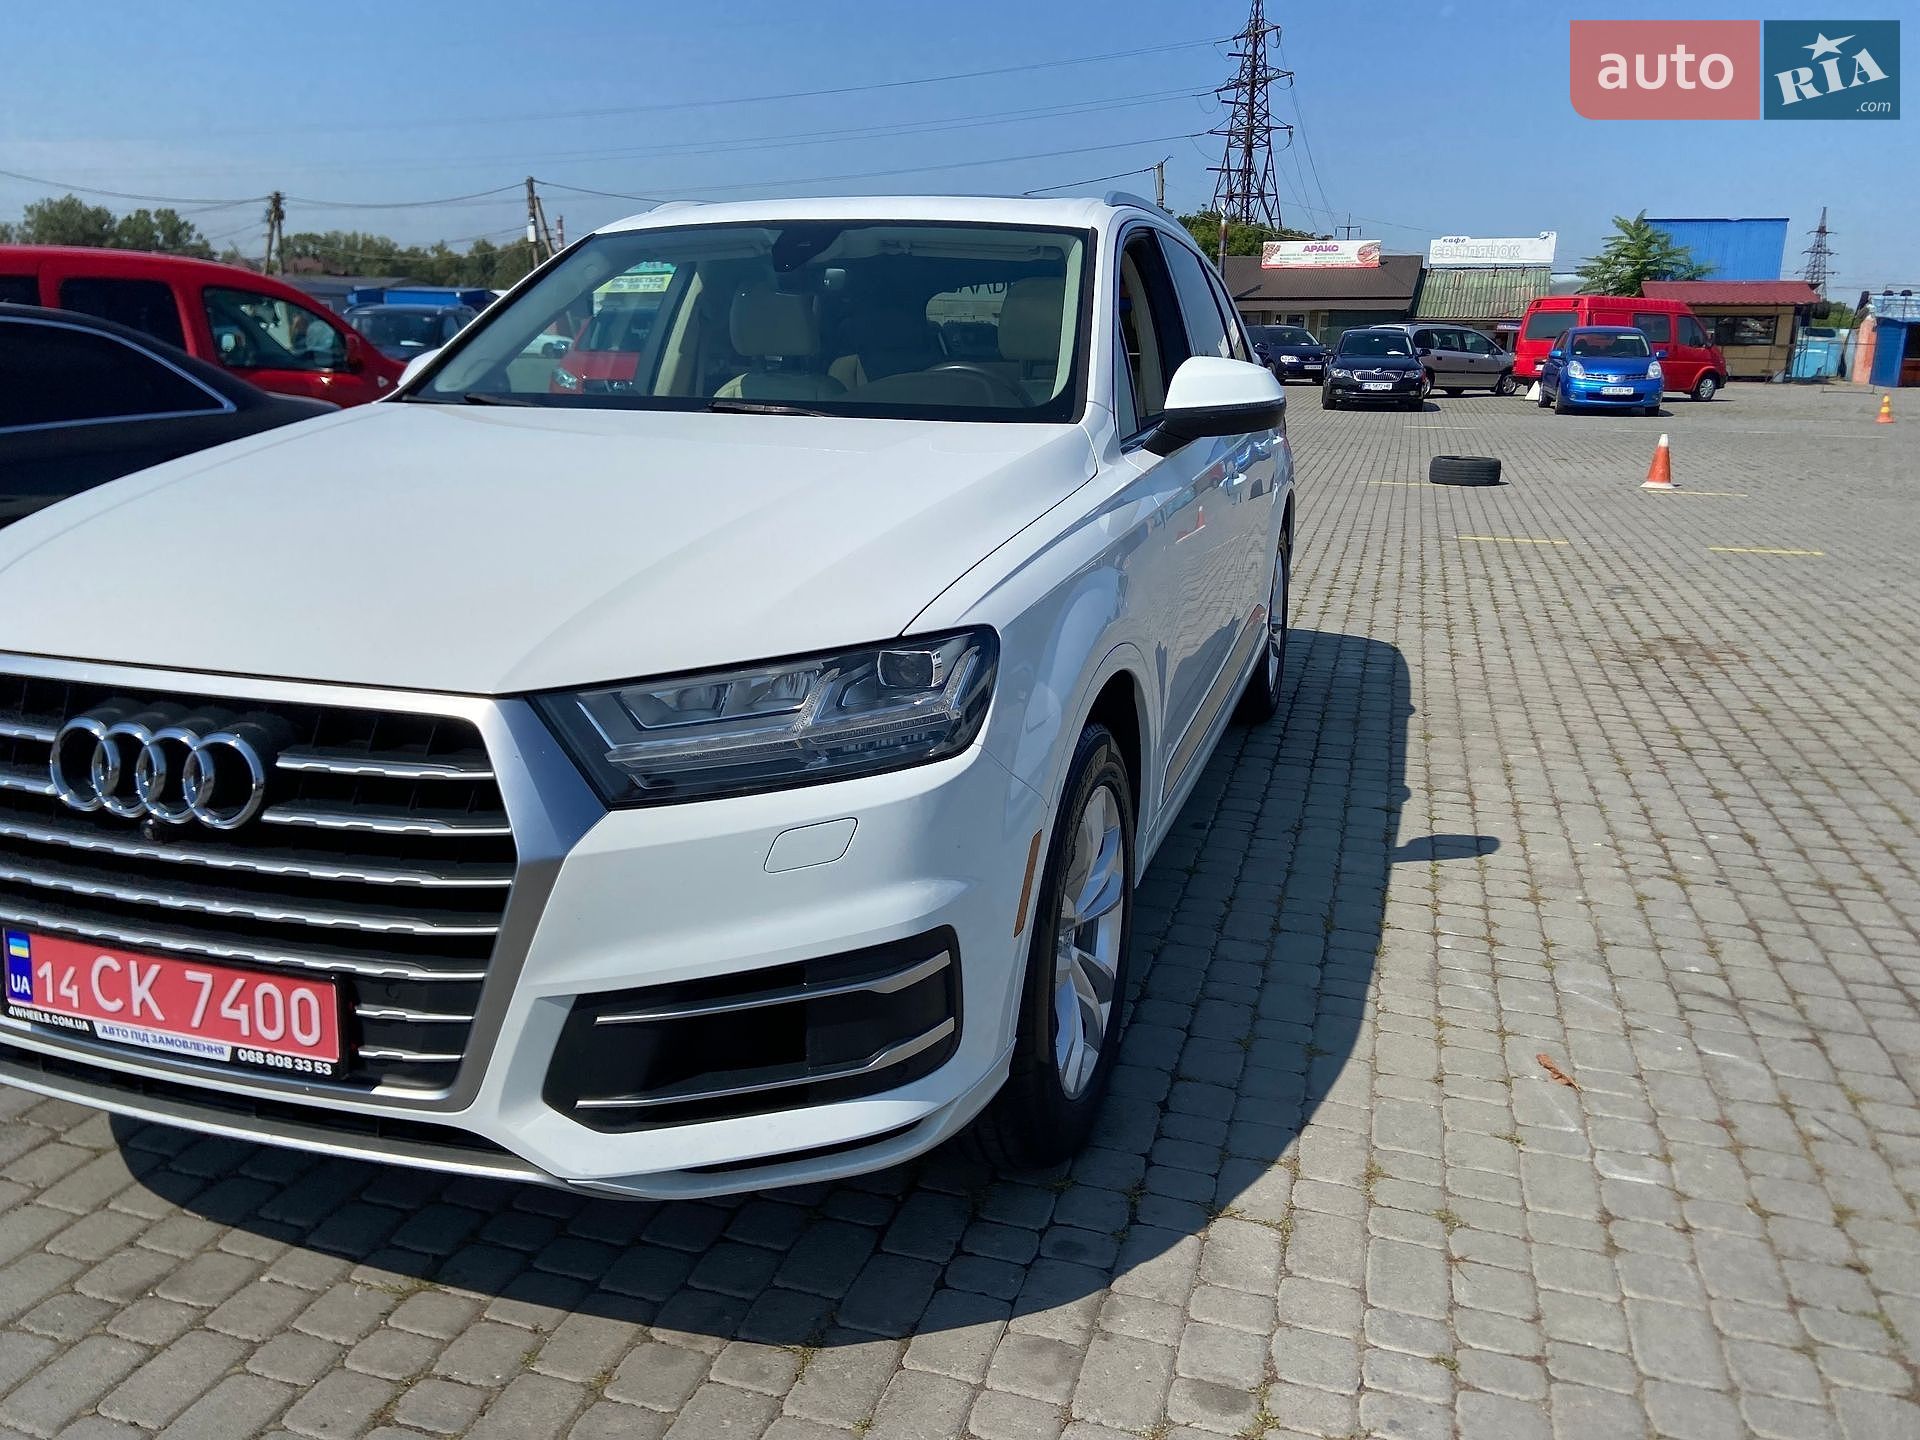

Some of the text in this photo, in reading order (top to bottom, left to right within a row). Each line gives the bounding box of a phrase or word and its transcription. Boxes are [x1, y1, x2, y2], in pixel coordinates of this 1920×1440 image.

[11, 972, 32, 995] UA
[37, 955, 322, 1047] 14 CK 7400
[8, 1005, 90, 1032] 4WHEELS.COM.UA
[101, 1025, 225, 1056] АВТО ПІД ЗАМОВЛЕННЯ
[237, 1048, 333, 1076] 068 808 33 53
